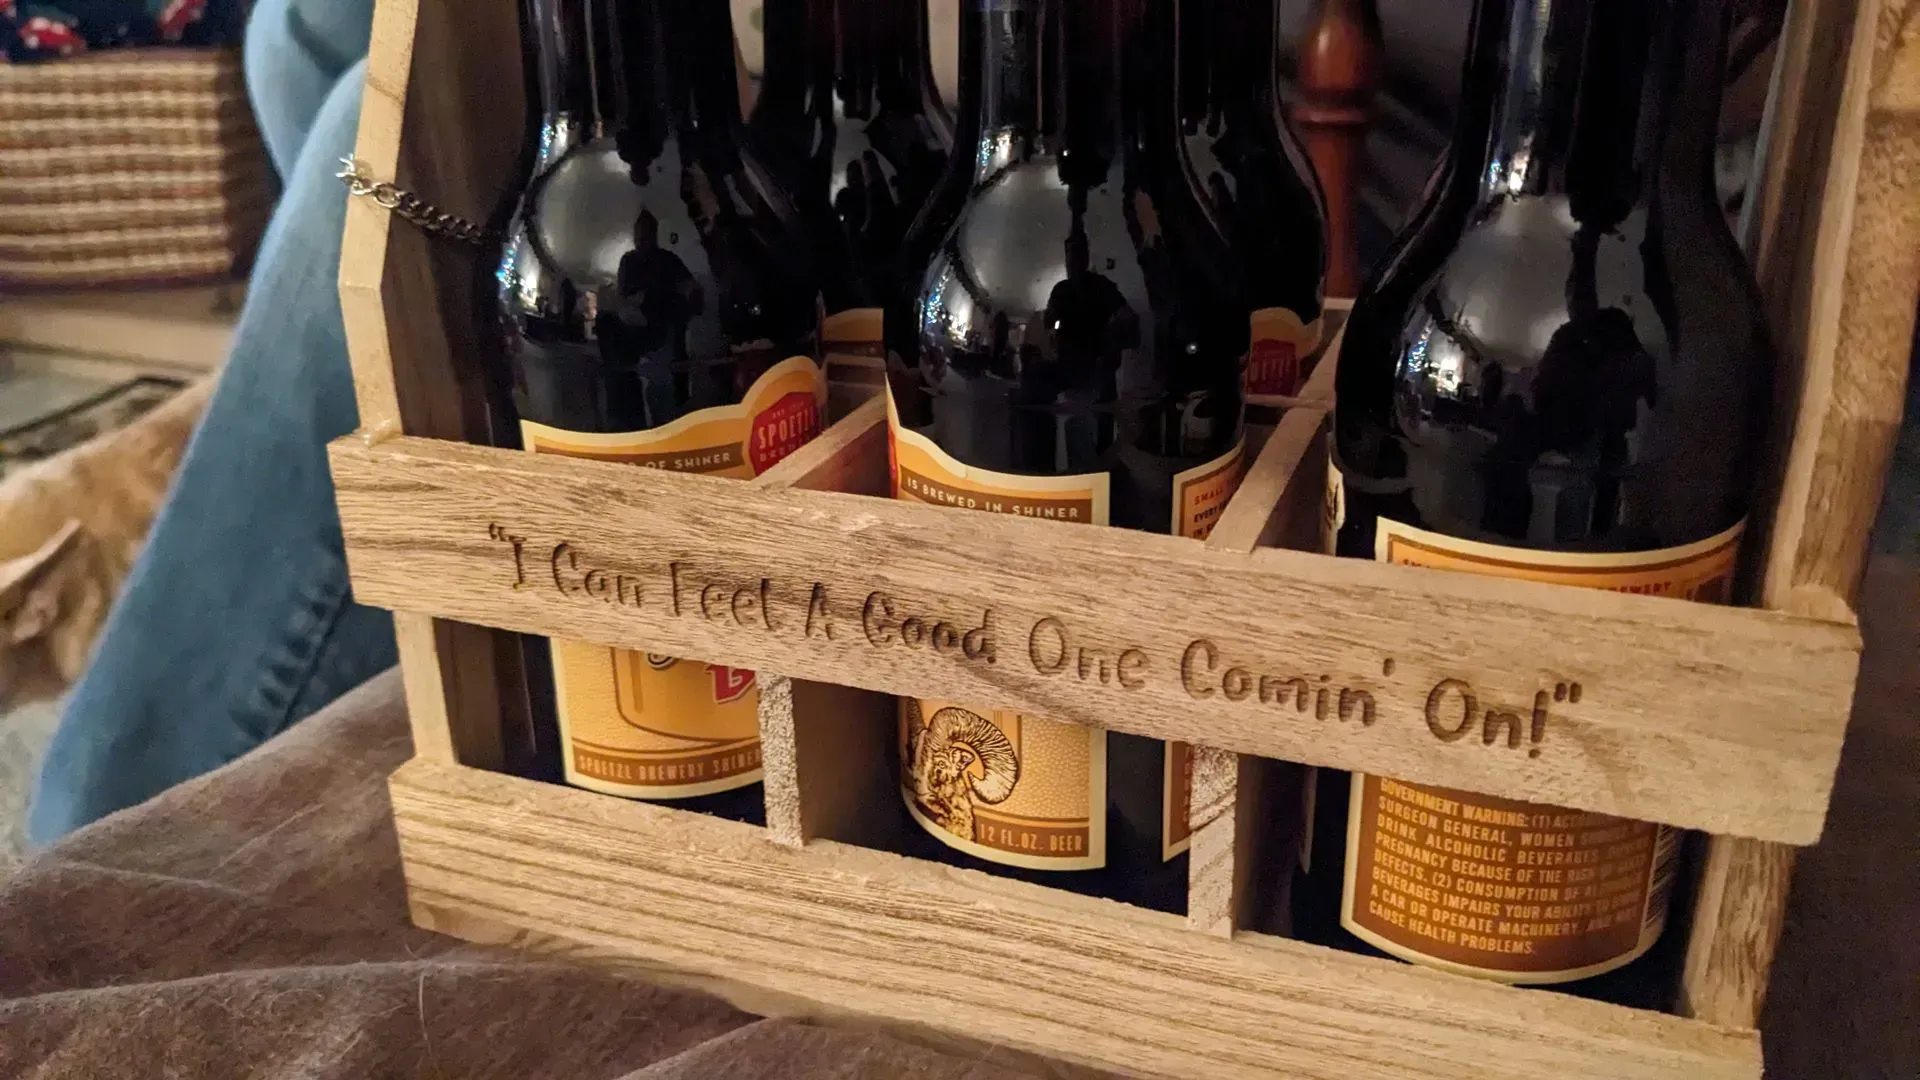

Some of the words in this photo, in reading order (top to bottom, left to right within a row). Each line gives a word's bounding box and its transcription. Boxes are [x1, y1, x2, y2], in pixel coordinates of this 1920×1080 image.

[673, 452, 731, 470] SHINER
[907, 477, 919, 490] IS
[922, 484, 977, 510] BREWED
[985, 502, 1002, 513] IN
[1011, 505, 1079, 519] SHINER
[551, 541, 643, 608] Can
[669, 560, 782, 633] Feel
[804, 581, 835, 643] A
[861, 590, 997, 665] Good
[1028, 615, 1153, 692] One
[1180, 637, 1397, 728] Comin'
[572, 754, 633, 780] SPOETZL
[638, 762, 705, 782] BREWERY
[1378, 795, 1439, 830] SURGEON
[1442, 818, 1513, 847] GENERAL,
[1519, 831, 1576, 849] WOMEN
[1380, 777, 1460, 817] GOVERNMENT
[980, 823, 996, 843] 12
[1049, 834, 1083, 852] BEER
[1374, 830, 1448, 869] PREGNANCY
[1451, 858, 1513, 883] BECAUSE
[1516, 868, 1536, 885] OF
[1538, 870, 1562, 885] THE
[1377, 813, 1418, 842] DRINK
[1424, 833, 1508, 863] ALCOHOLIC
[1515, 849, 1600, 867] BEVERAGES
[1371, 866, 1440, 904] BEVERAGES
[1443, 891, 1501, 917] IMPAIRS
[1503, 904, 1541, 921] YOUR
[1373, 847, 1429, 883] DEFECTS.
[1431, 871, 1452, 889] (2)
[1455, 877, 1560, 903] CONSUMPTION
[1368, 899, 1407, 929] CAUSE
[1408, 918, 1458, 945] HEALTH
[1370, 883, 1380, 898] A
[1381, 888, 1406, 911] CAR
[1409, 900, 1428, 918] OR
[1431, 907, 1495, 934] OPERATE
